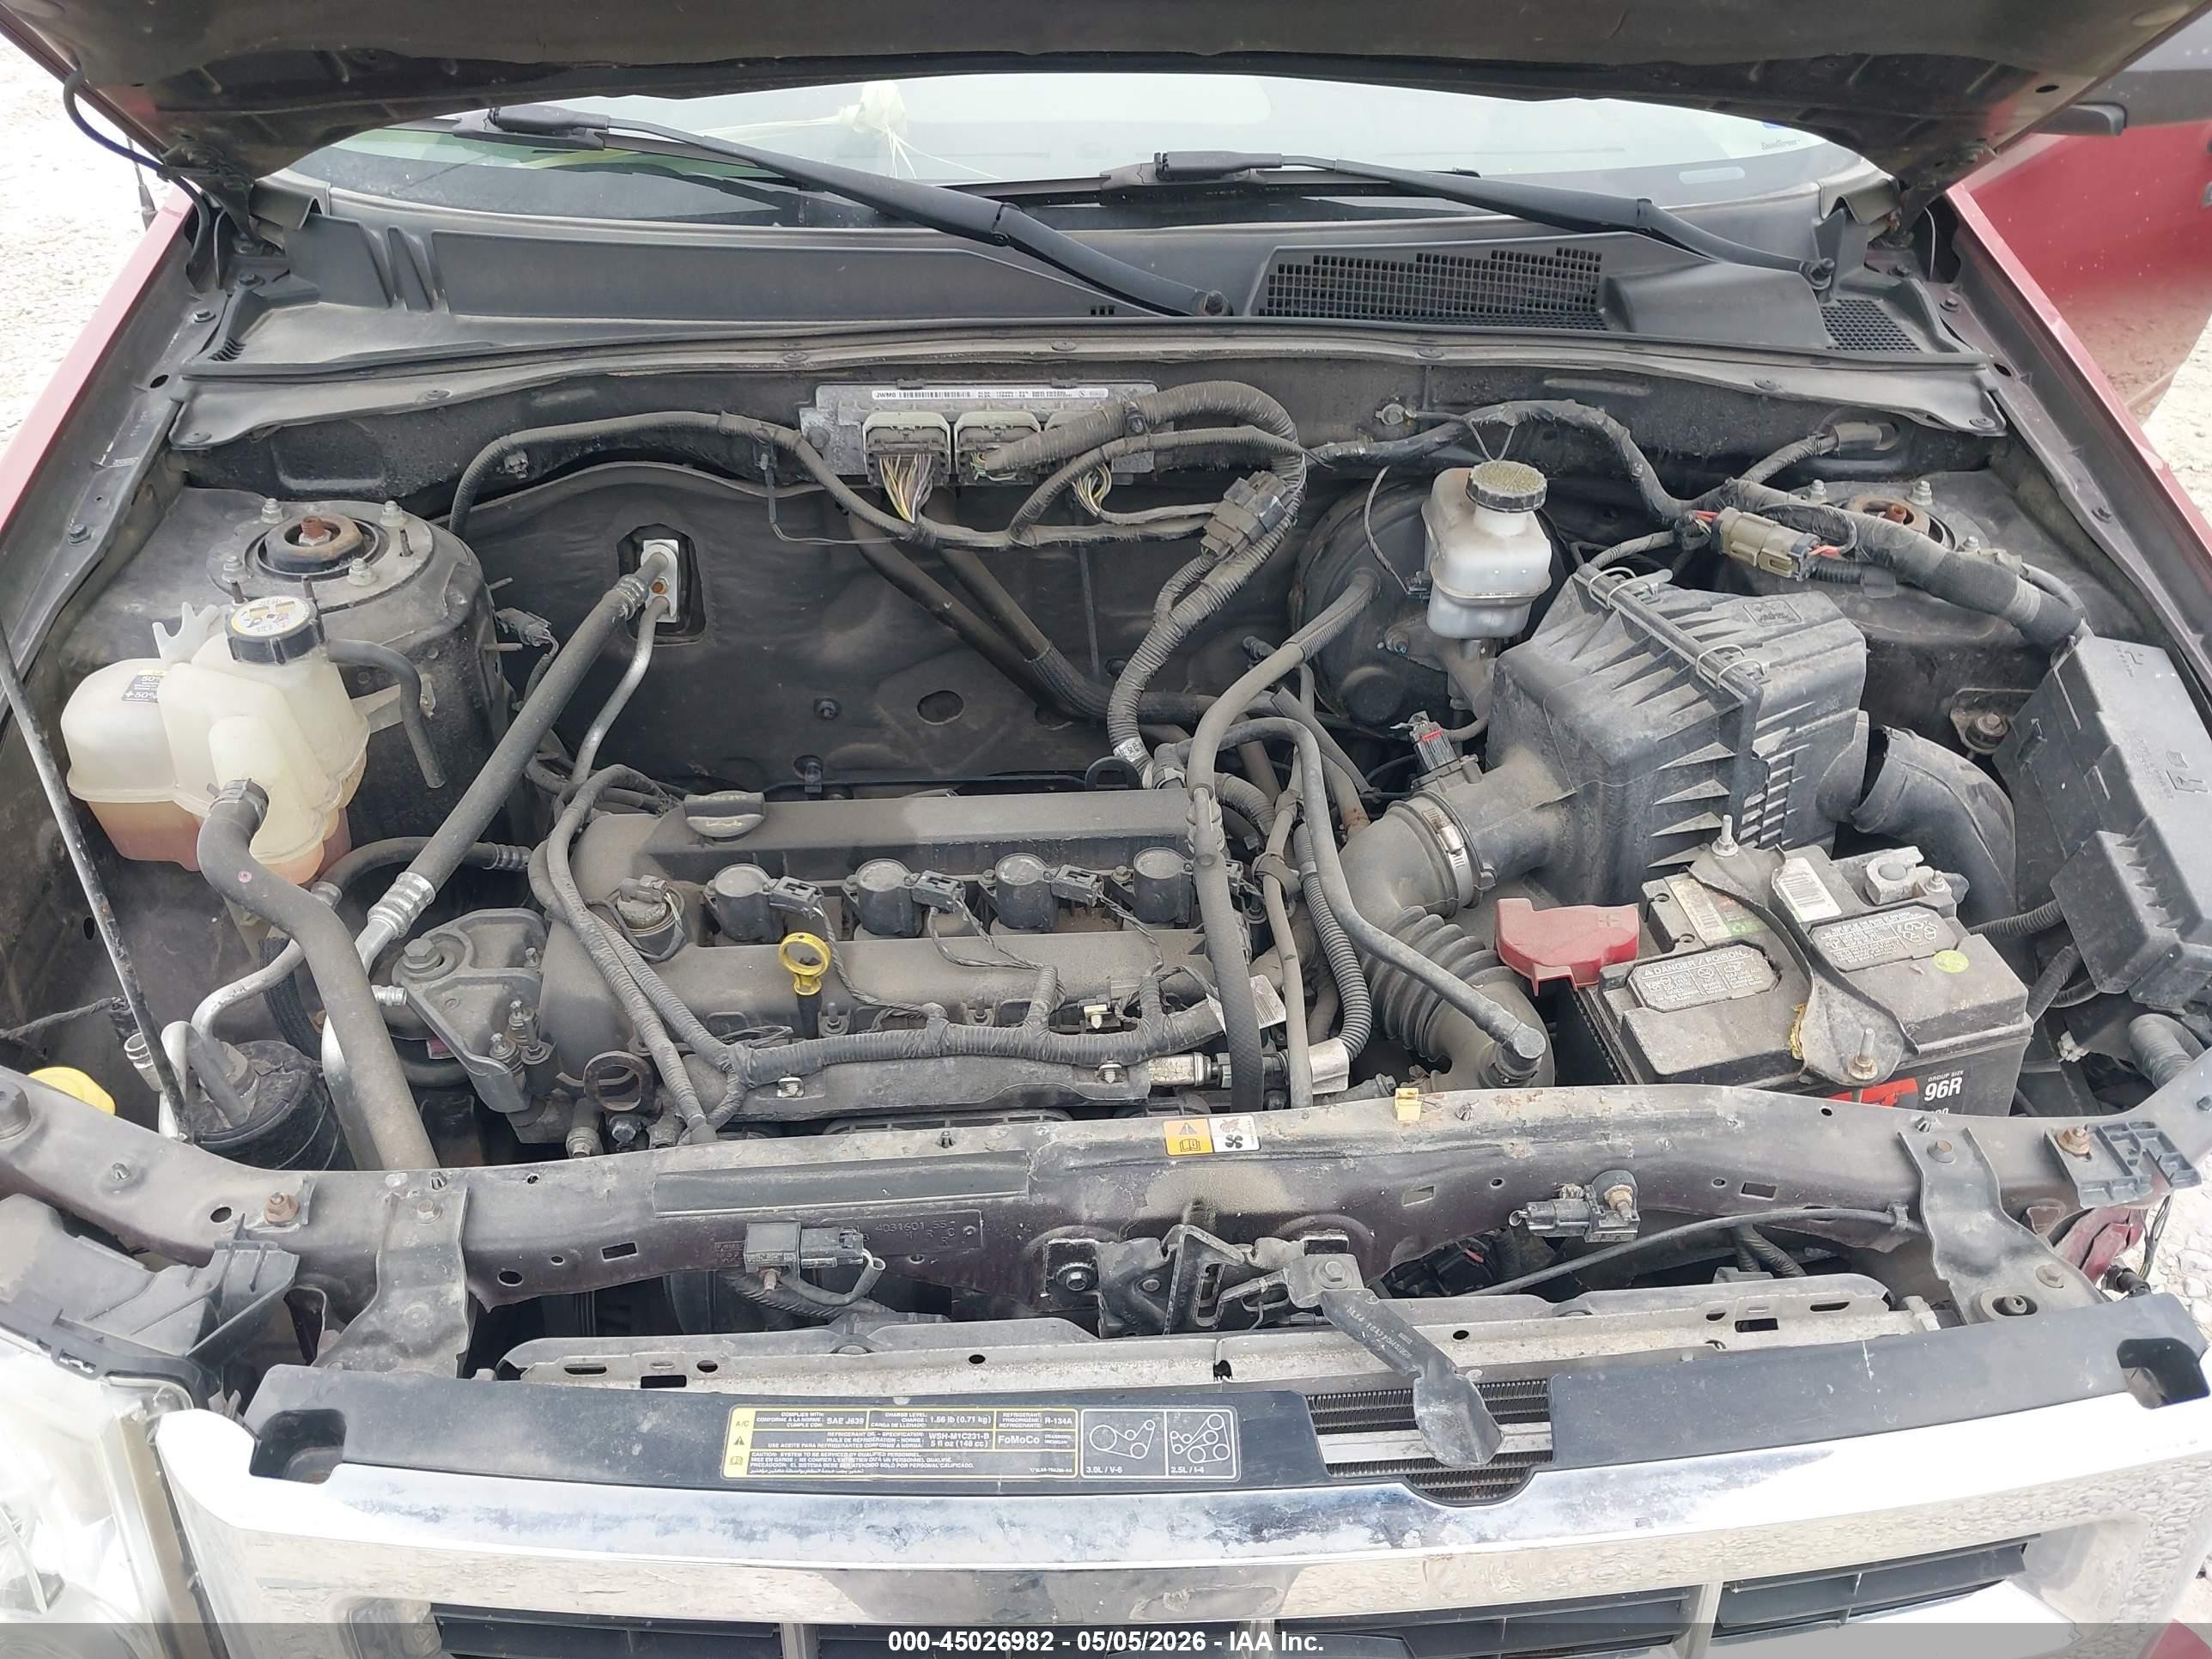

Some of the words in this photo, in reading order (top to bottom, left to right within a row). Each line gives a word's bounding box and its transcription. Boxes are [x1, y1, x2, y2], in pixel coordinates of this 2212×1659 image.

[1653, 960, 1695, 975] DANGER
[1928, 1073, 1949, 1082] GROUP
[1924, 1077, 1963, 1102] 96R
[978, 1415, 991, 1424] kg)
[998, 1435, 1040, 1444] FoMoCo
